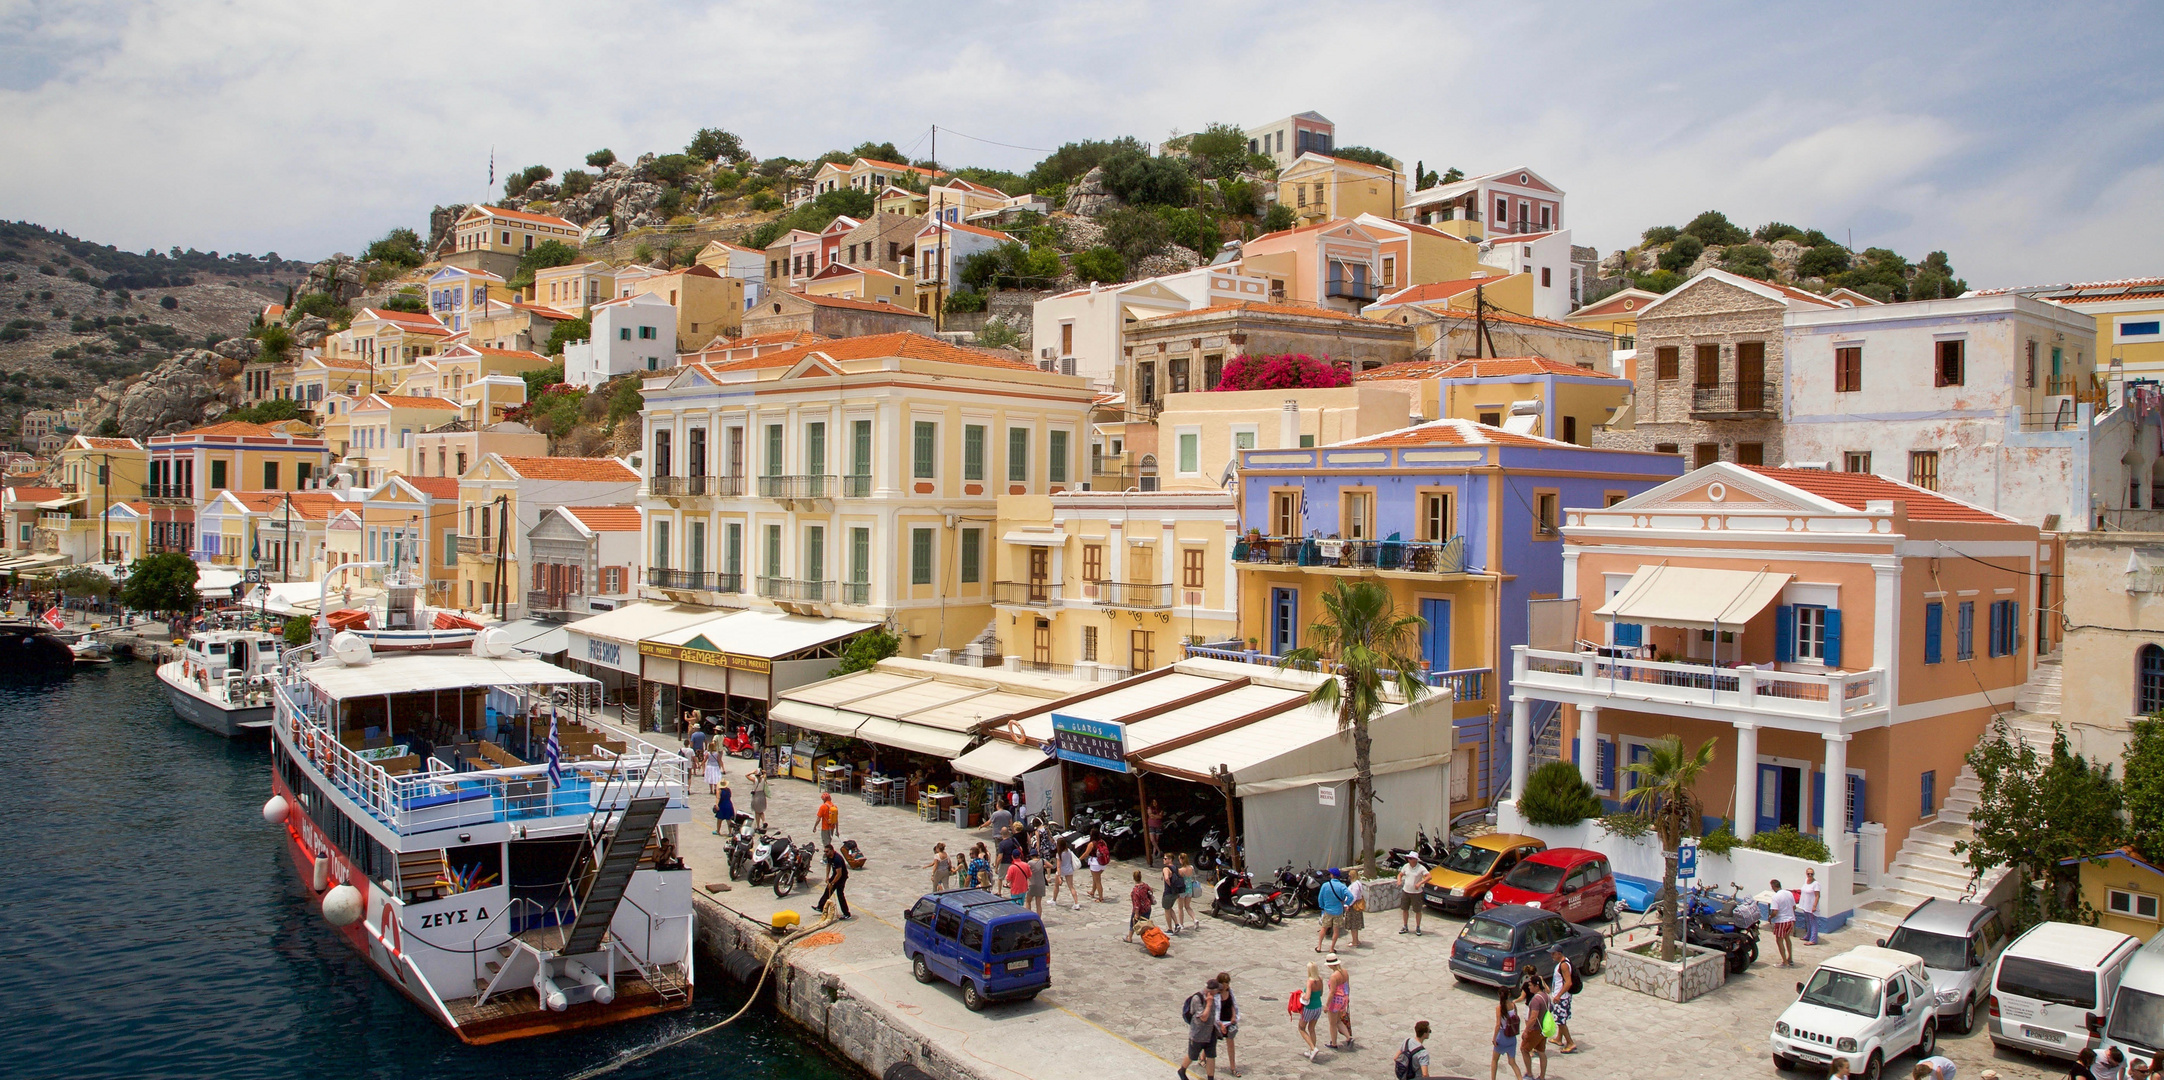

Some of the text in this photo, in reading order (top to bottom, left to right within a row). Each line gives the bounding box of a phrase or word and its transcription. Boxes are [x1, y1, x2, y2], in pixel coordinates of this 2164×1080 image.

[591, 639, 620, 666] FREE SHOPS
[640, 644, 673, 656] SUPER MARKET
[731, 657, 768, 669] SUPER MARKET
[1072, 723, 1102, 735] GLAROS
[1060, 732, 1117, 751] CAR & BIKE
[1061, 741, 1119, 760] RENTALS
[1682, 849, 1692, 863] P
[421, 907, 489, 929] ΖΕΥΣ Δ
